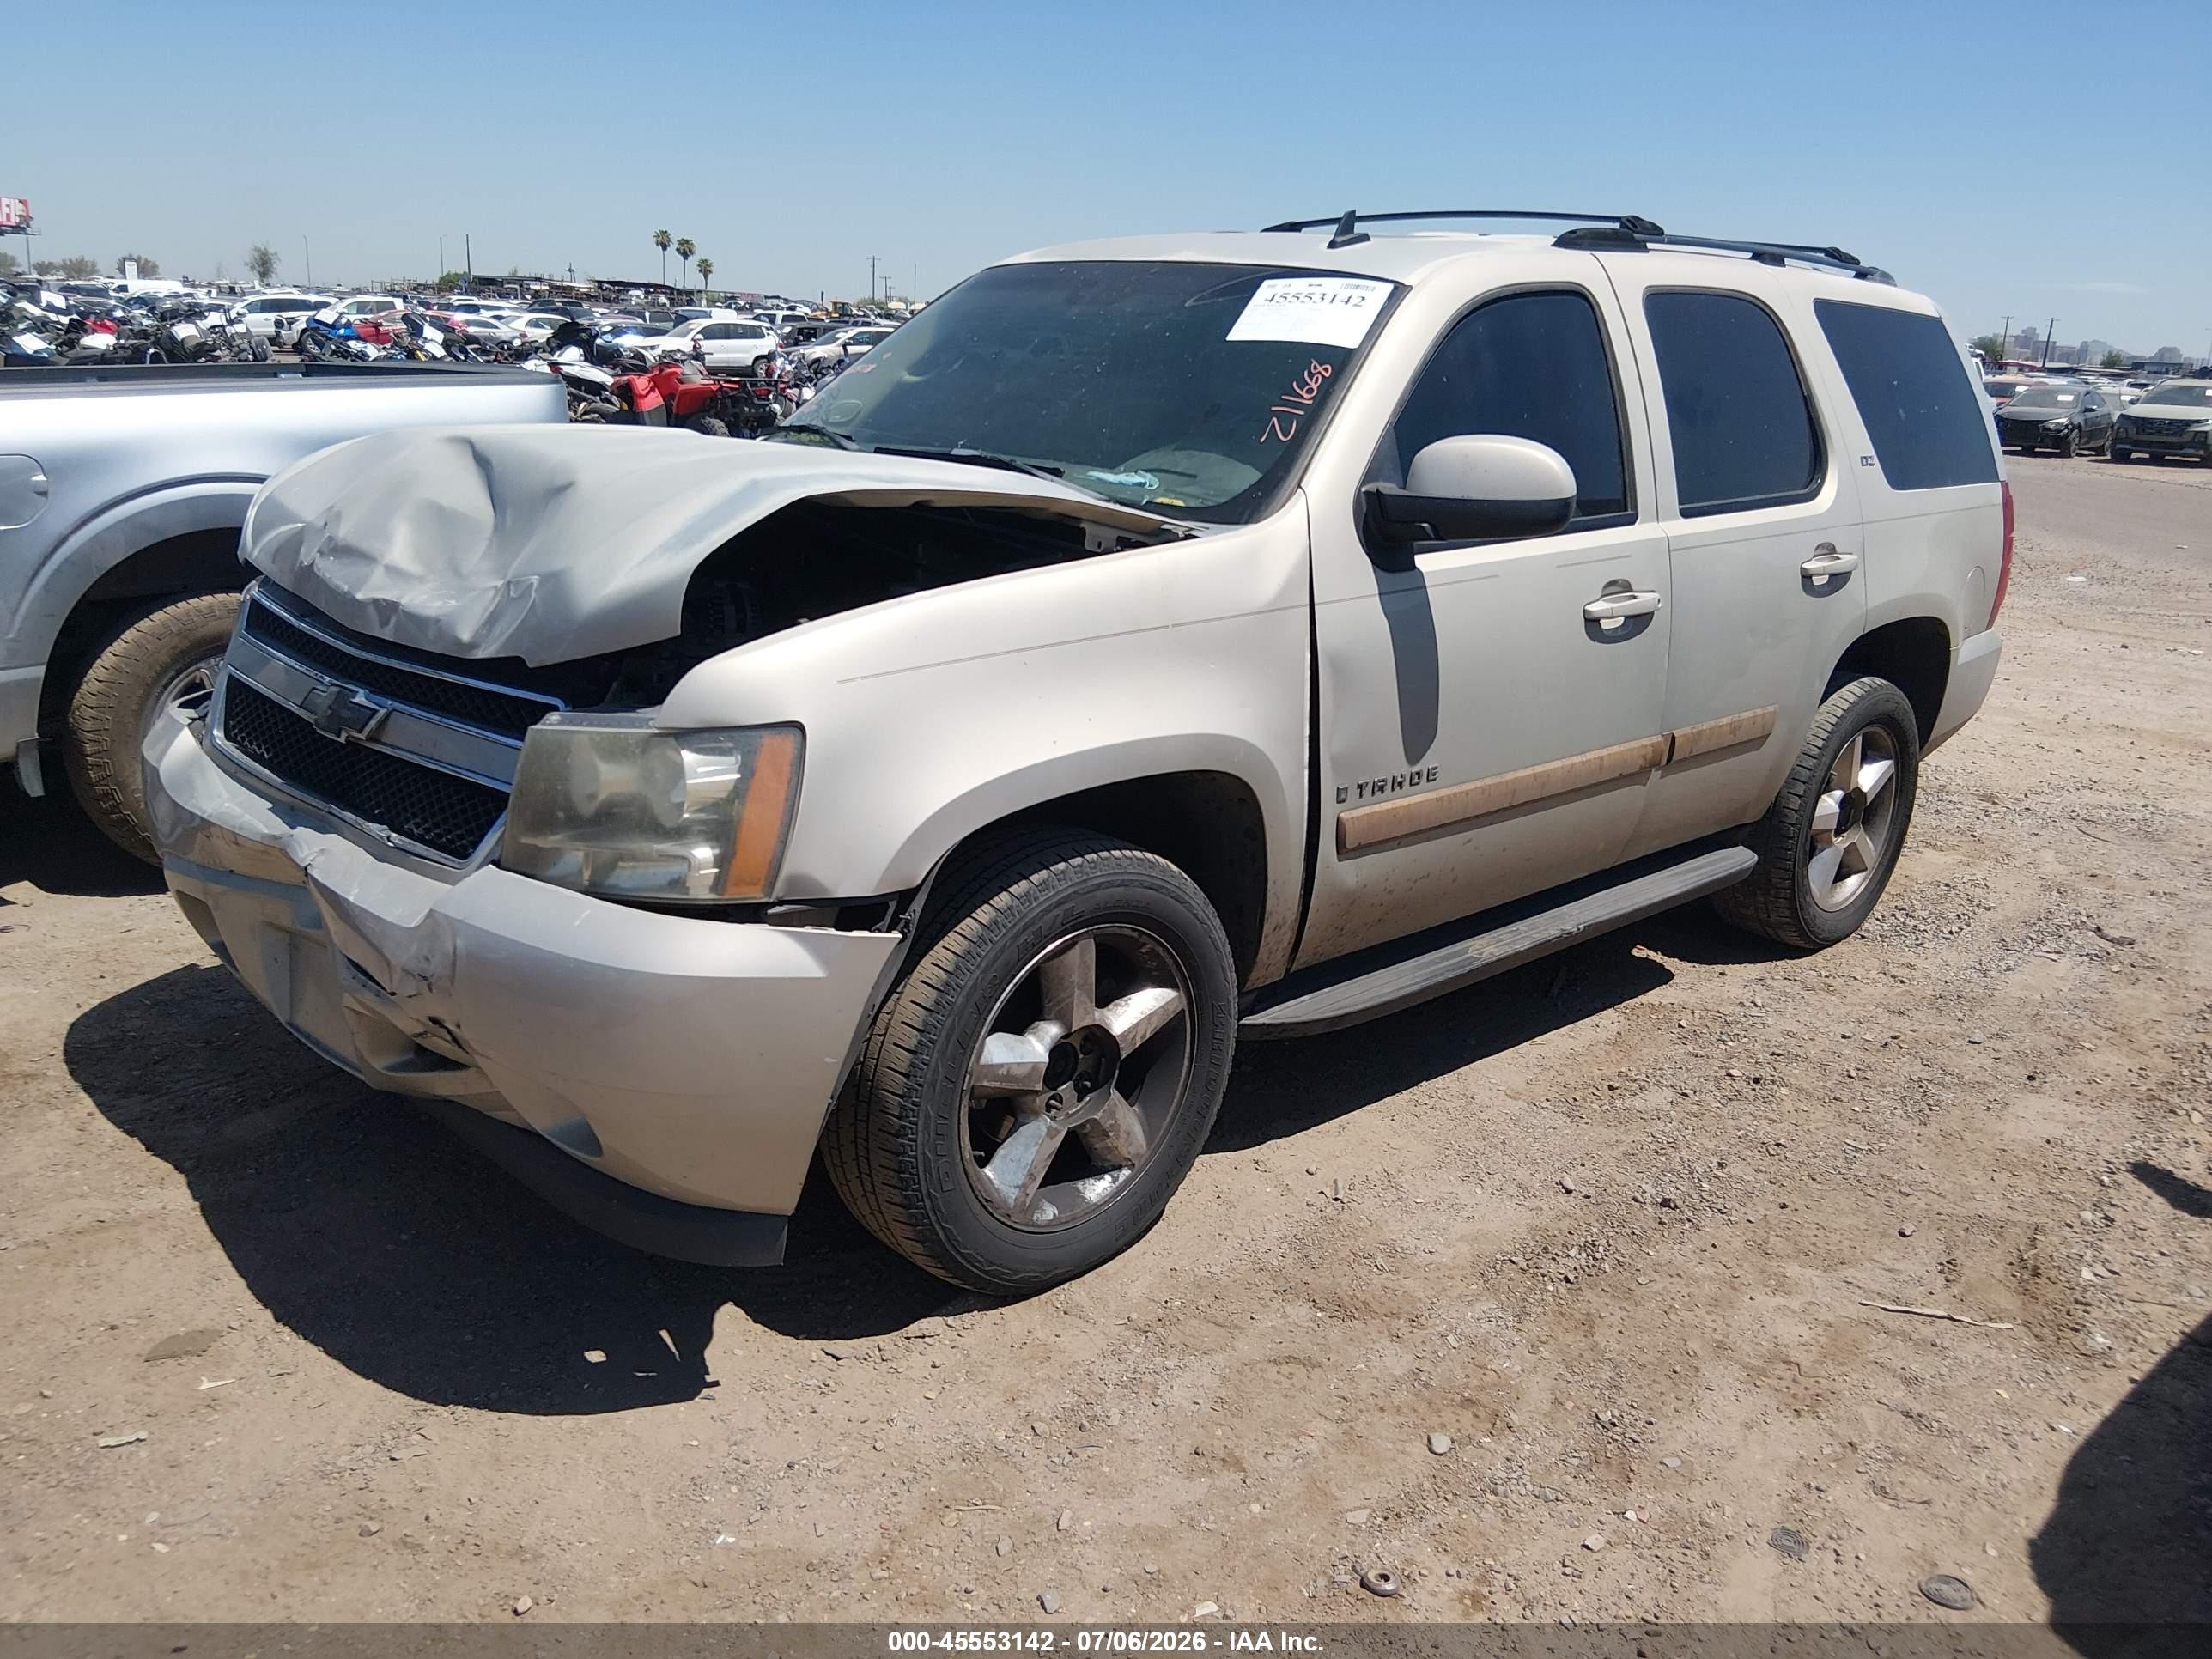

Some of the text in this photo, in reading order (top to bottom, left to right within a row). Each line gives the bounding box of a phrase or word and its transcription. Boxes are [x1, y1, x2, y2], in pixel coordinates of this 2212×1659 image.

[1264, 292, 1366, 307] 45553142
[1260, 359, 1333, 443] 211668
[1357, 763, 1440, 799] TAHOE
